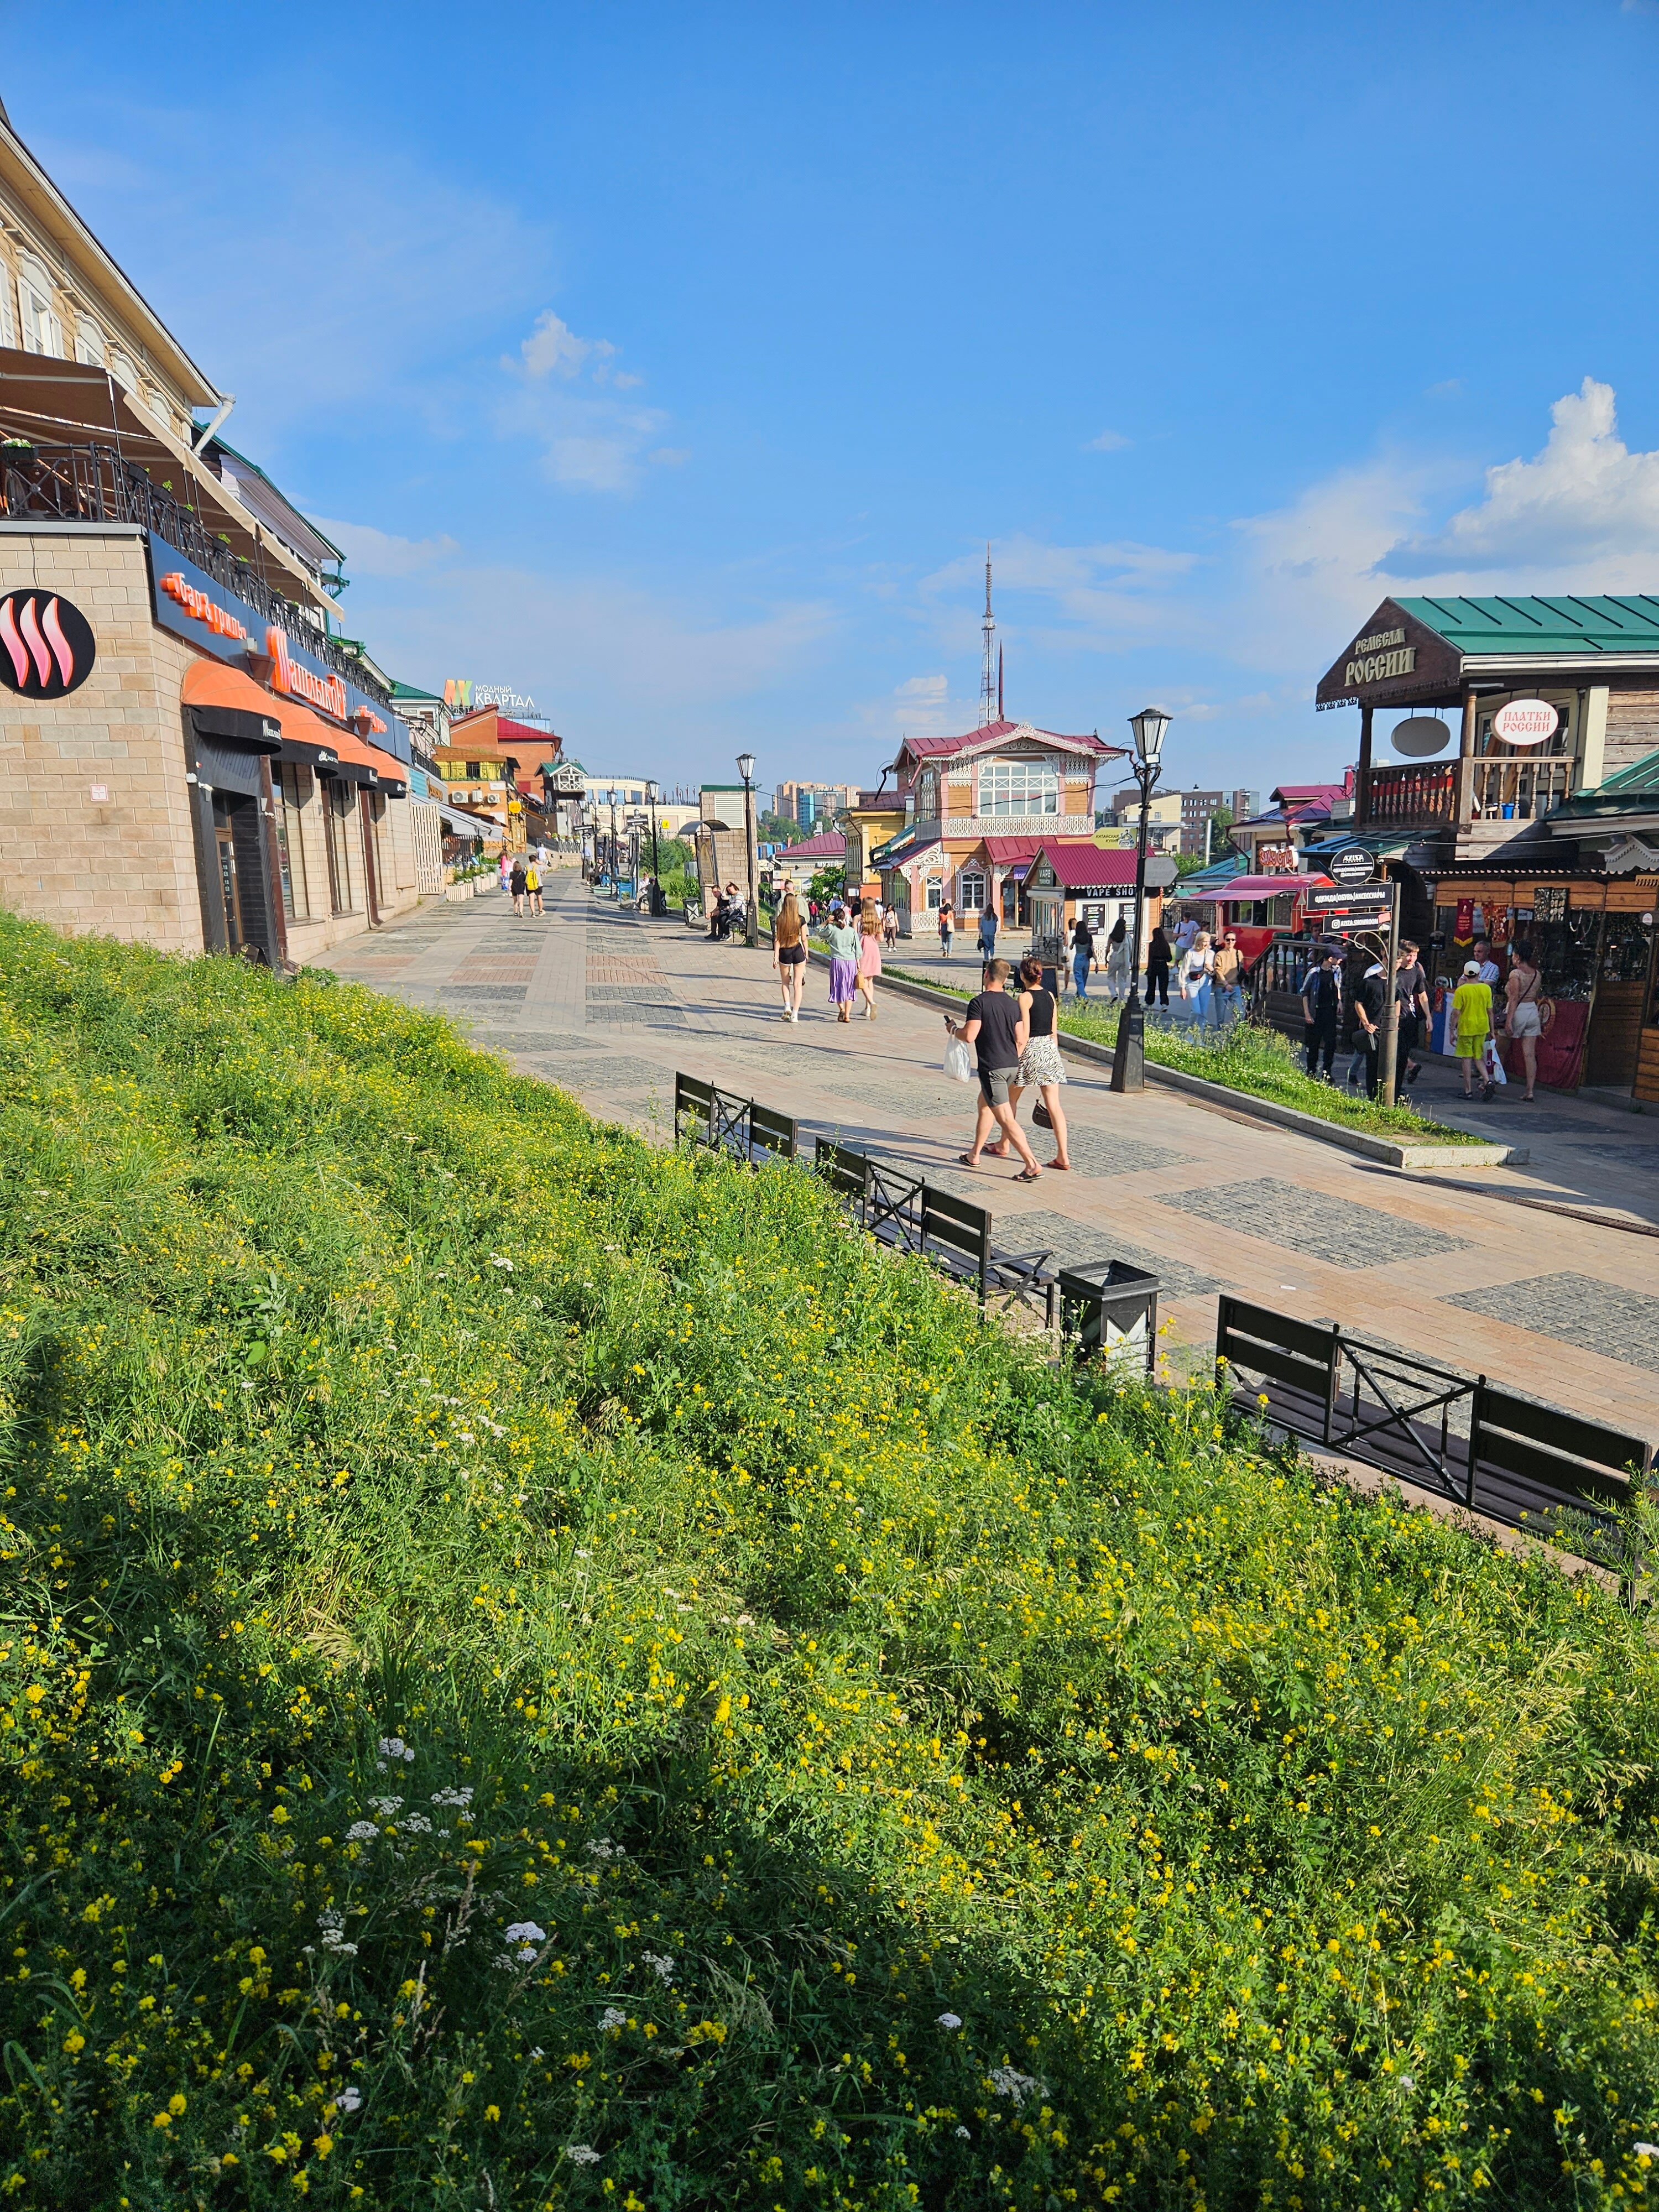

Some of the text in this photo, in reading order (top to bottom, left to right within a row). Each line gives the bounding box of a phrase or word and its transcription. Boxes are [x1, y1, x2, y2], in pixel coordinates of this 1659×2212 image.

[1355, 628, 1406, 655] РЕМЕСЛА
[1344, 648, 1416, 686] РОССИИ
[475, 685, 512, 693] МОДНЫЙ
[475, 692, 535, 708] КВАРТАЛ
[1504, 712, 1551, 721] ПЛАТКИ
[1502, 722, 1550, 732] РОССИИ
[1039, 869, 1051, 878] VAPE
[1087, 888, 1136, 896] VAPE SHO
